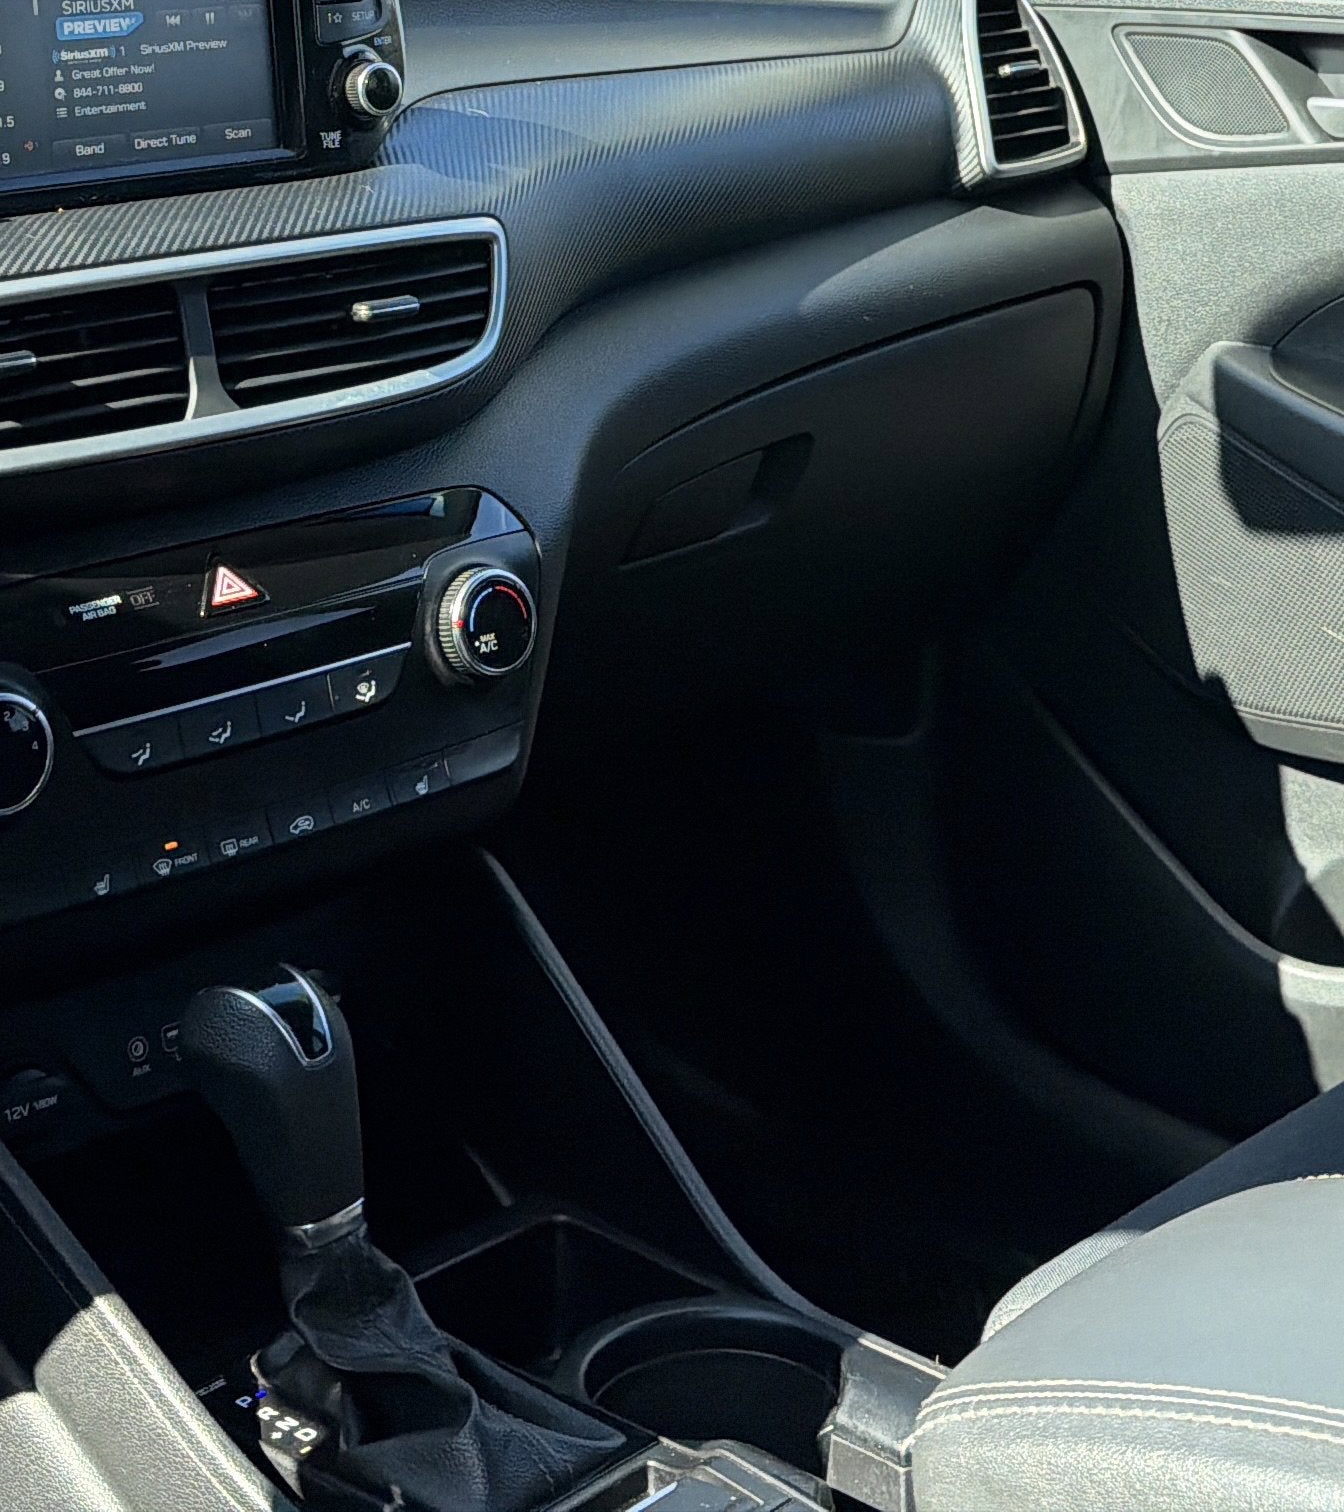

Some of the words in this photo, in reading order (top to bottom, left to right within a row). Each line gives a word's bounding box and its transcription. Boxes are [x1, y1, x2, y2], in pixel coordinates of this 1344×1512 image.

[351, 10, 375, 22] SETUP
[63, 16, 137, 36] PREVIEW
[139, 40, 185, 56] SiriusXM
[186, 38, 228, 54] Preview
[72, 68, 102, 81] Great
[102, 65, 129, 78] Offer
[130, 63, 156, 75] Now!
[75, 100, 147, 117] Entertainment
[135, 136, 169, 151] Direct
[170, 133, 197, 147] Tune
[224, 127, 252, 141] Scan
[320, 130, 342, 141] TUNE
[75, 142, 105, 156] Band
[479, 639, 499, 654] A/C
[351, 797, 372, 814] A/C
[174, 852, 198, 867] FRONT
[4, 1101, 31, 1123] 12V
[235, 1395, 253, 1408] P
